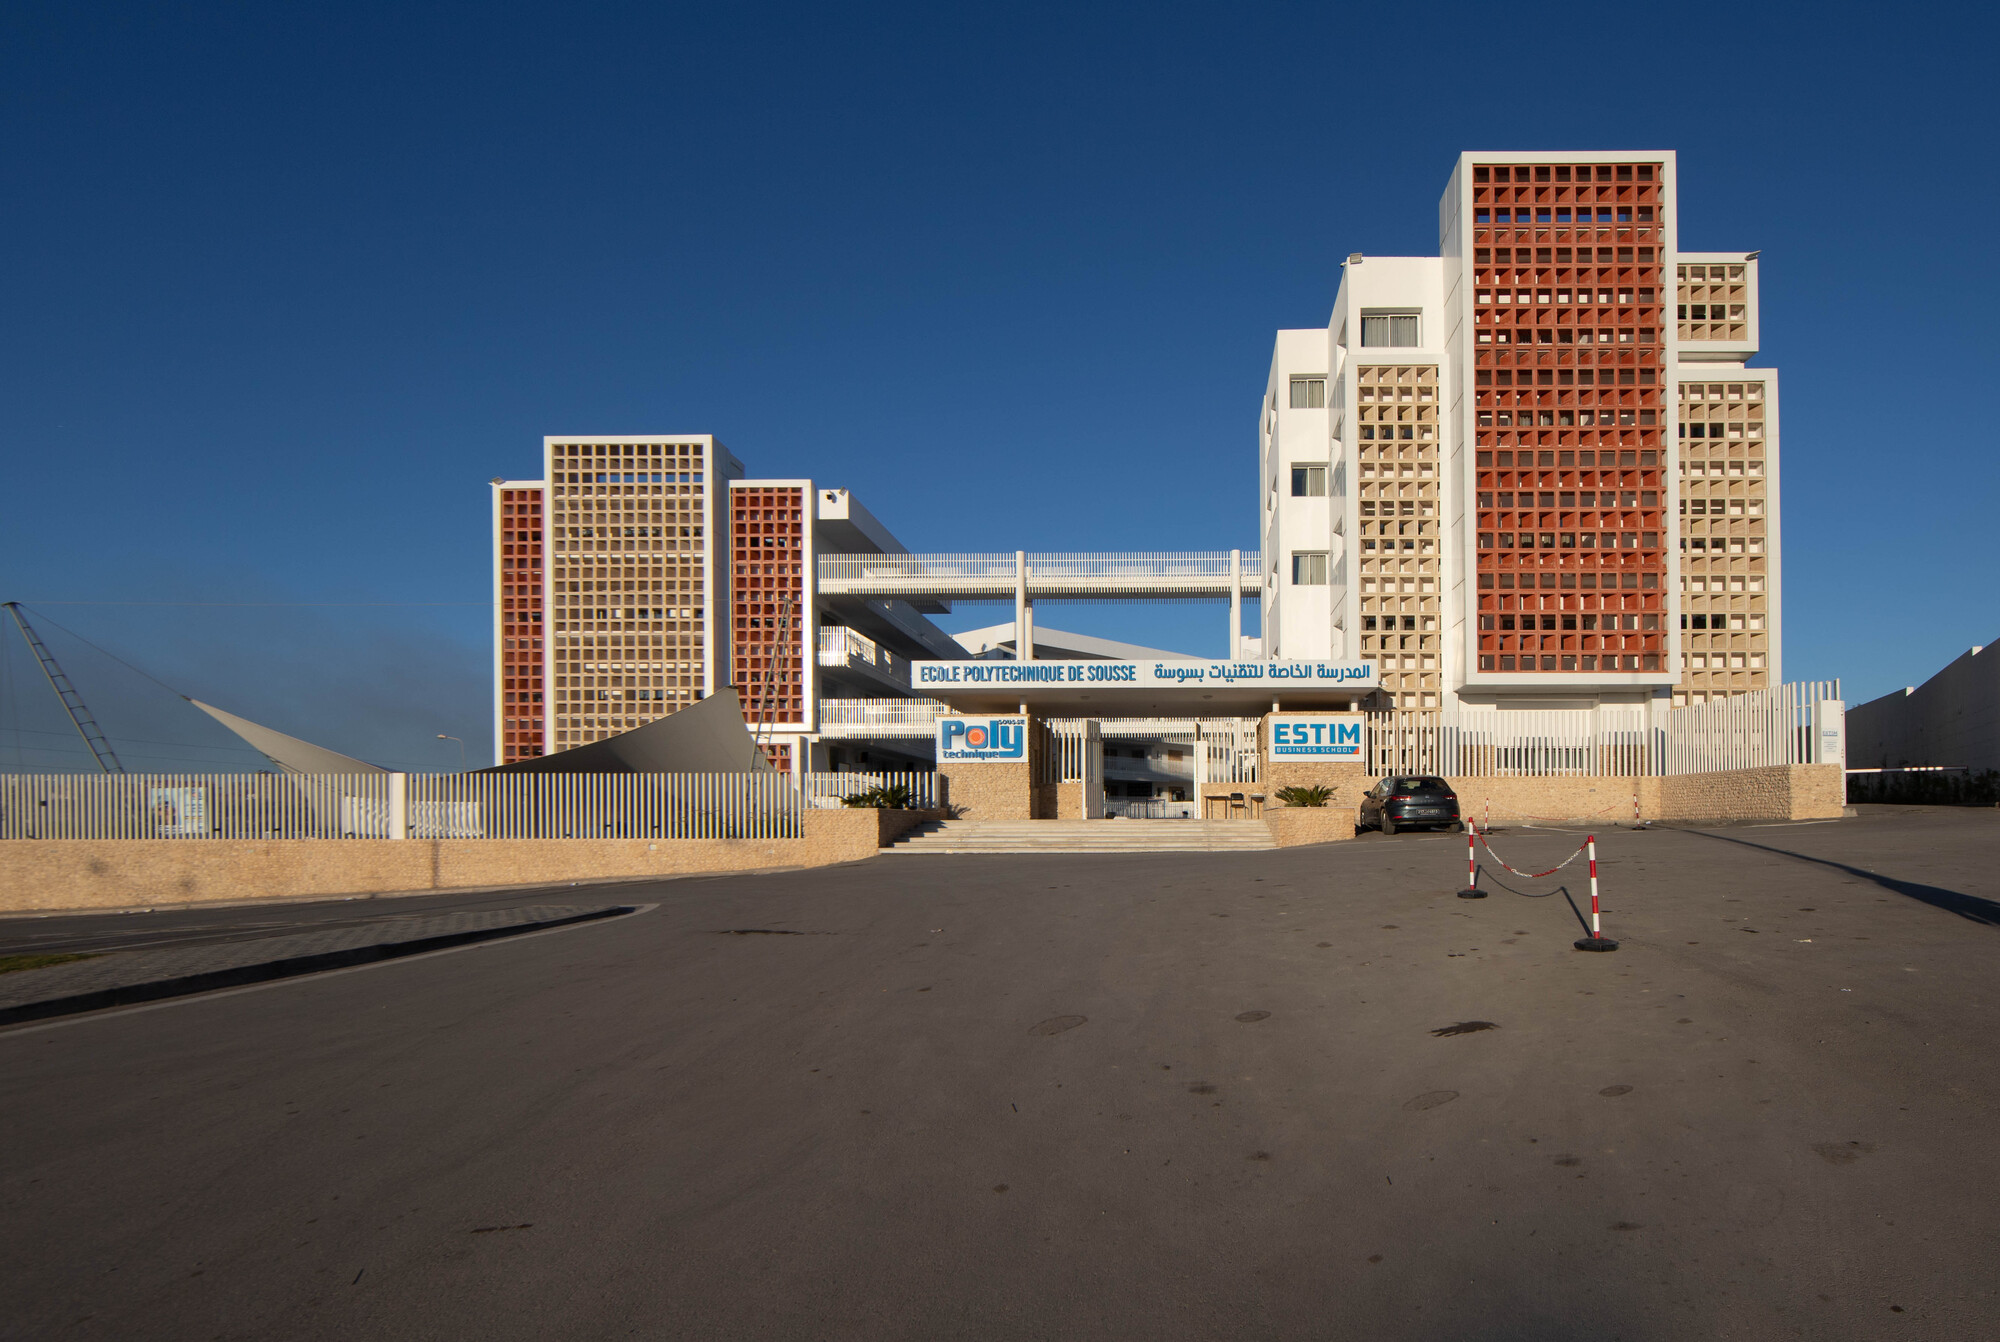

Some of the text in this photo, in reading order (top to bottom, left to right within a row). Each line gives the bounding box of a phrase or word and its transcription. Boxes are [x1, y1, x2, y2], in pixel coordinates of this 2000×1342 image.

[920, 665, 1137, 682] ECOLE POLYTECHNIQUE DE SOUSSE
[1154, 663, 1370, 683] المدرسة الخاصة للتقنيات بسوسة
[941, 720, 1024, 758] Poly
[1274, 723, 1360, 744] ESTIM
[942, 749, 999, 760] technique
